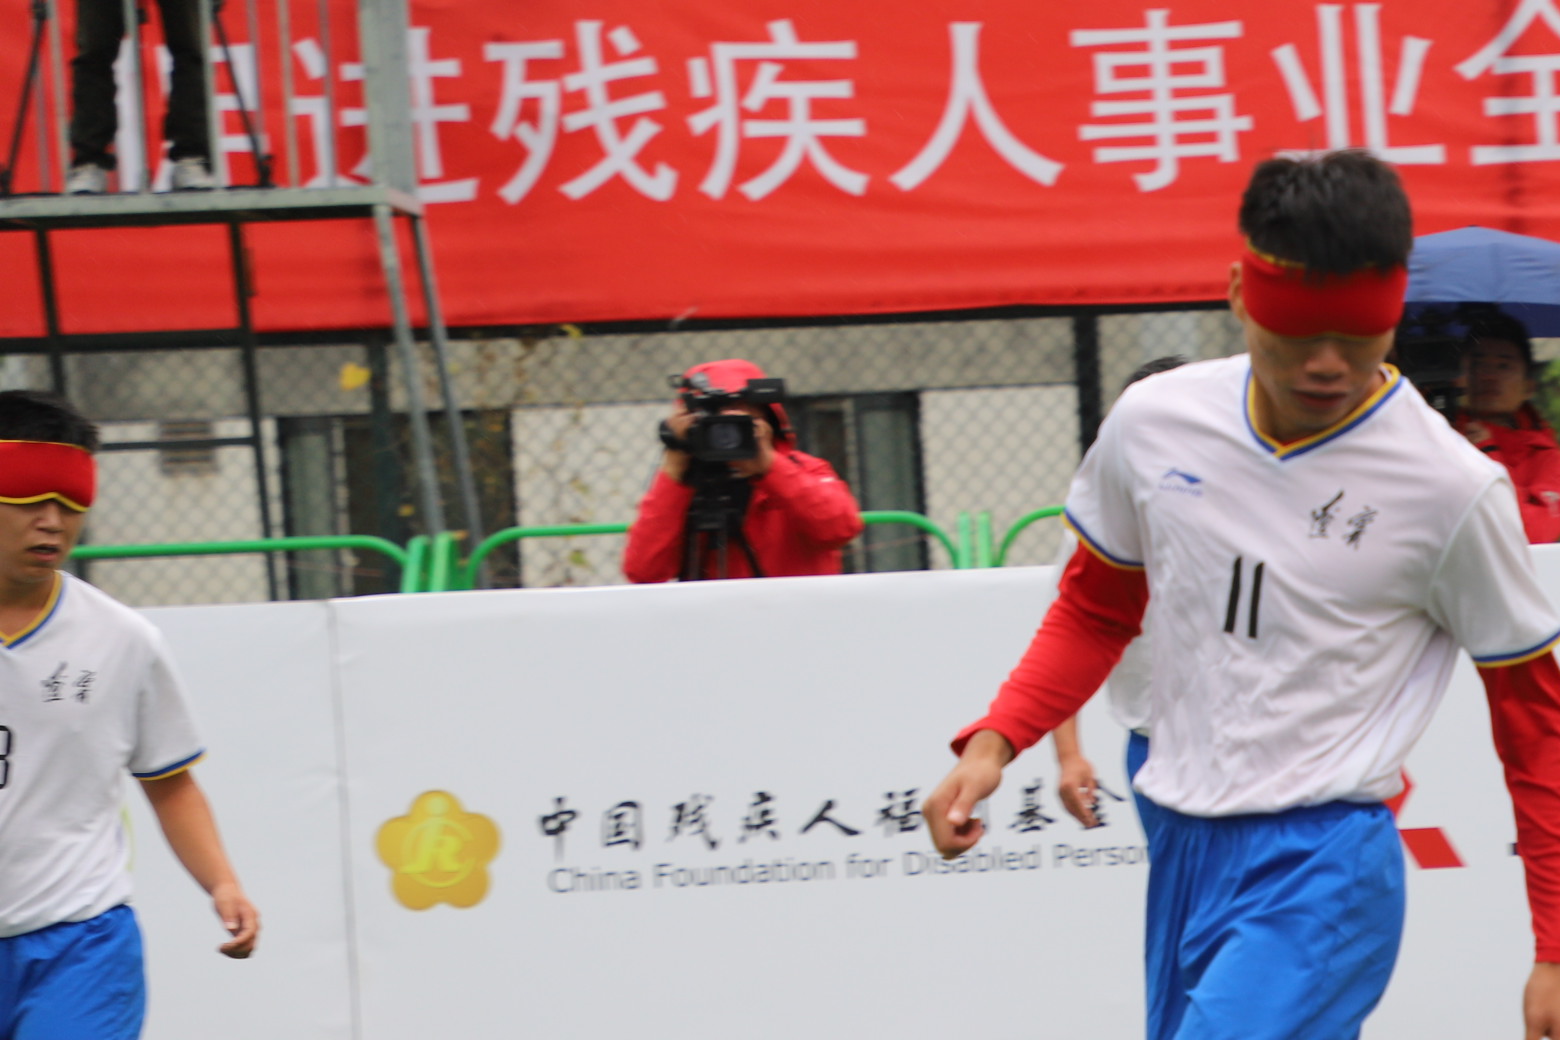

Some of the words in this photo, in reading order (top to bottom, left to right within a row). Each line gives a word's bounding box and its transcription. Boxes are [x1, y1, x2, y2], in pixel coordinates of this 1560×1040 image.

[1223, 555, 1264, 639] 11
[547, 865, 643, 893] China
[653, 857, 835, 888] Foundation
[846, 852, 892, 878] for
[902, 845, 1041, 876] Disabled
